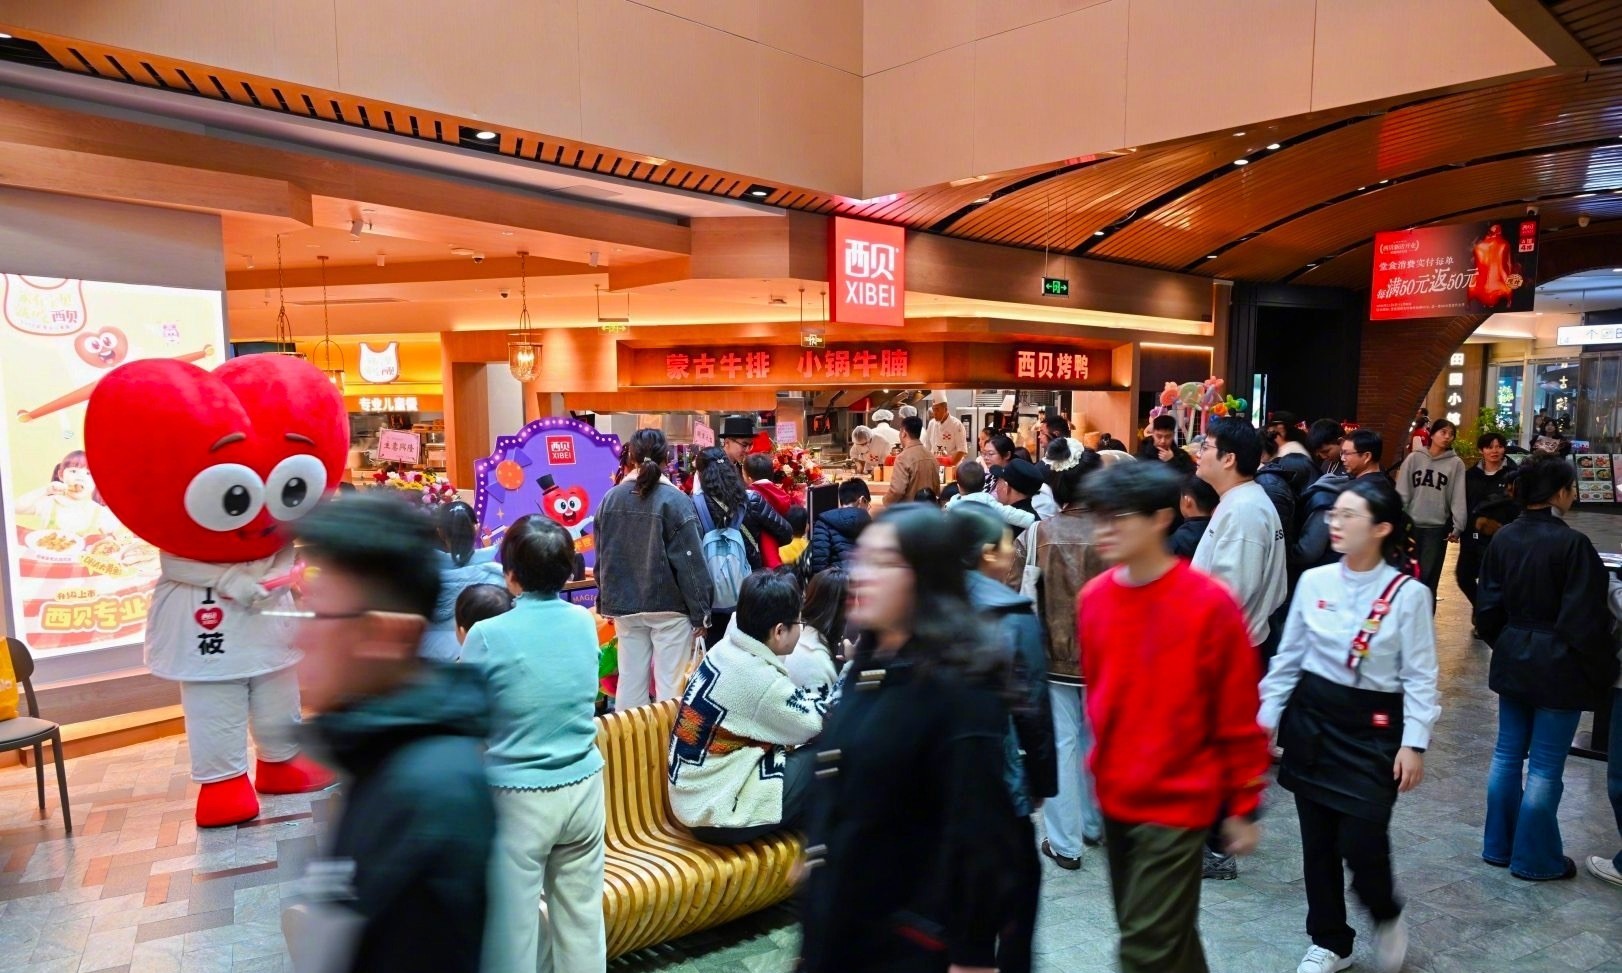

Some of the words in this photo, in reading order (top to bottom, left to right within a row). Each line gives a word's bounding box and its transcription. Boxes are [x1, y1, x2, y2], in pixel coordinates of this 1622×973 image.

[845, 239, 895, 281] 西贝
[845, 280, 895, 308] XIBEI
[666, 352, 770, 379] 蒙古牛排
[797, 349, 908, 377] 小锅牛腩
[1017, 350, 1089, 379] 西贝烤鸭
[551, 441, 570, 452] 西贝
[1412, 469, 1449, 491] GAP
[45, 597, 152, 629] 西贝专业
